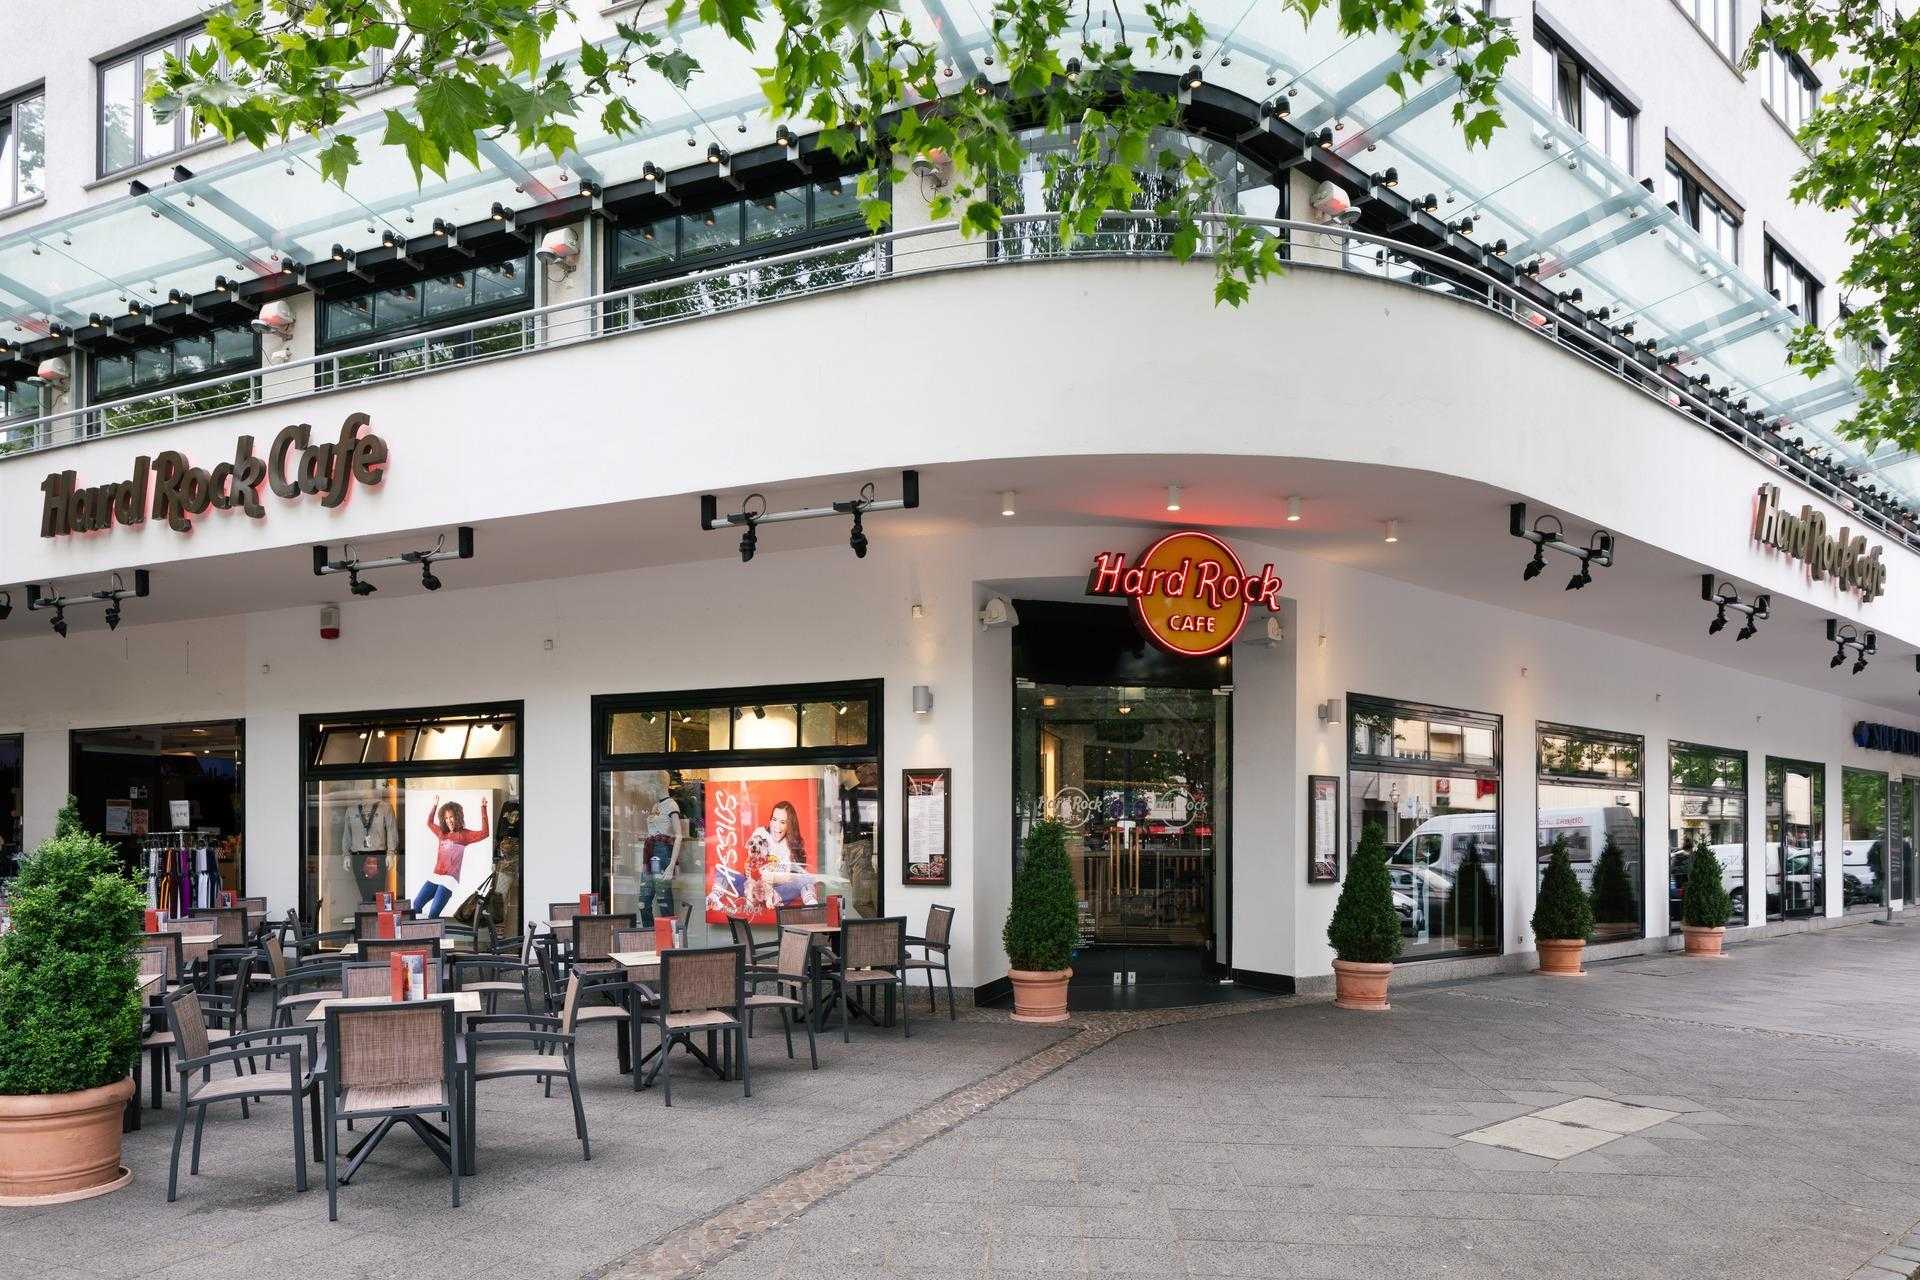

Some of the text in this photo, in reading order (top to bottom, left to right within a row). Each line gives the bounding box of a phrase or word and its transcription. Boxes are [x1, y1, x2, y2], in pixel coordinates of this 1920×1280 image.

[41, 412, 388, 537] Hard Rock Cafe
[1755, 482, 1886, 602] Hard Rock Cafe
[1095, 553, 1282, 611] Hard Rock
[1169, 615, 1216, 633] CAFE
[1072, 796, 1103, 812] Rock
[1181, 797, 1208, 816] ock
